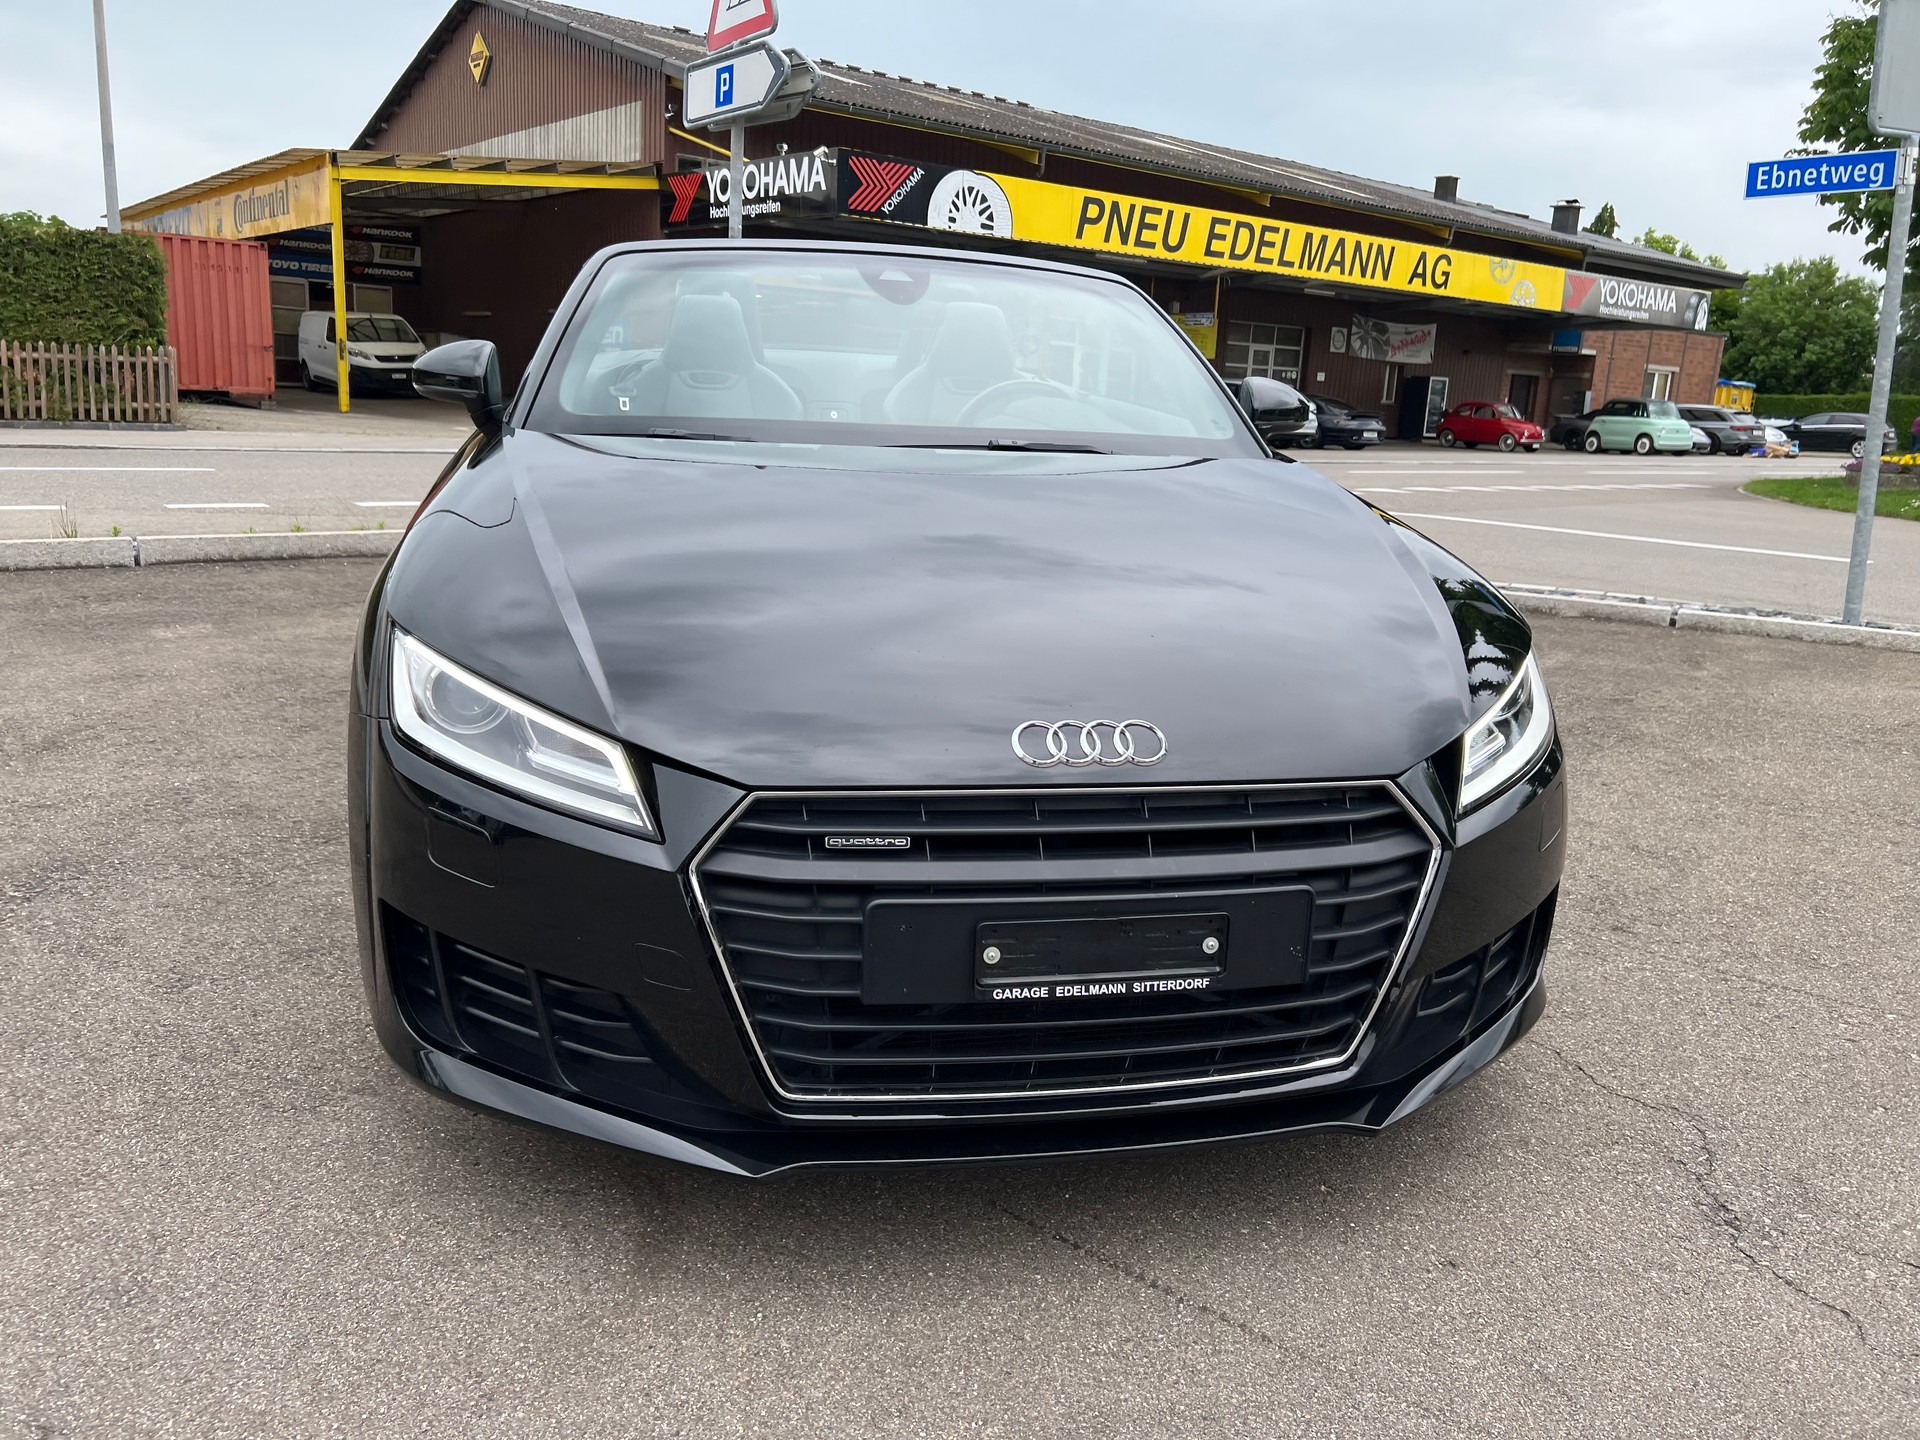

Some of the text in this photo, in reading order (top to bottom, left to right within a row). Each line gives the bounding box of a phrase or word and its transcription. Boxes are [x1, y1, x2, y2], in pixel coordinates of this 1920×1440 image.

[719, 72, 731, 103] P
[705, 157, 827, 204] YOOHAMA
[881, 166, 925, 215] YOKOHAMA
[1756, 162, 1885, 189] Ebnetweg
[234, 180, 290, 234] Continental
[710, 200, 781, 219] Hochlungsreifen
[1075, 196, 1453, 290] PNEU EDELMANN AG
[1600, 279, 1677, 313] YOKOHAMA
[829, 837, 907, 847] quattro
[993, 978, 1211, 1000] GARAGE EDELMANN SITTERDORF
